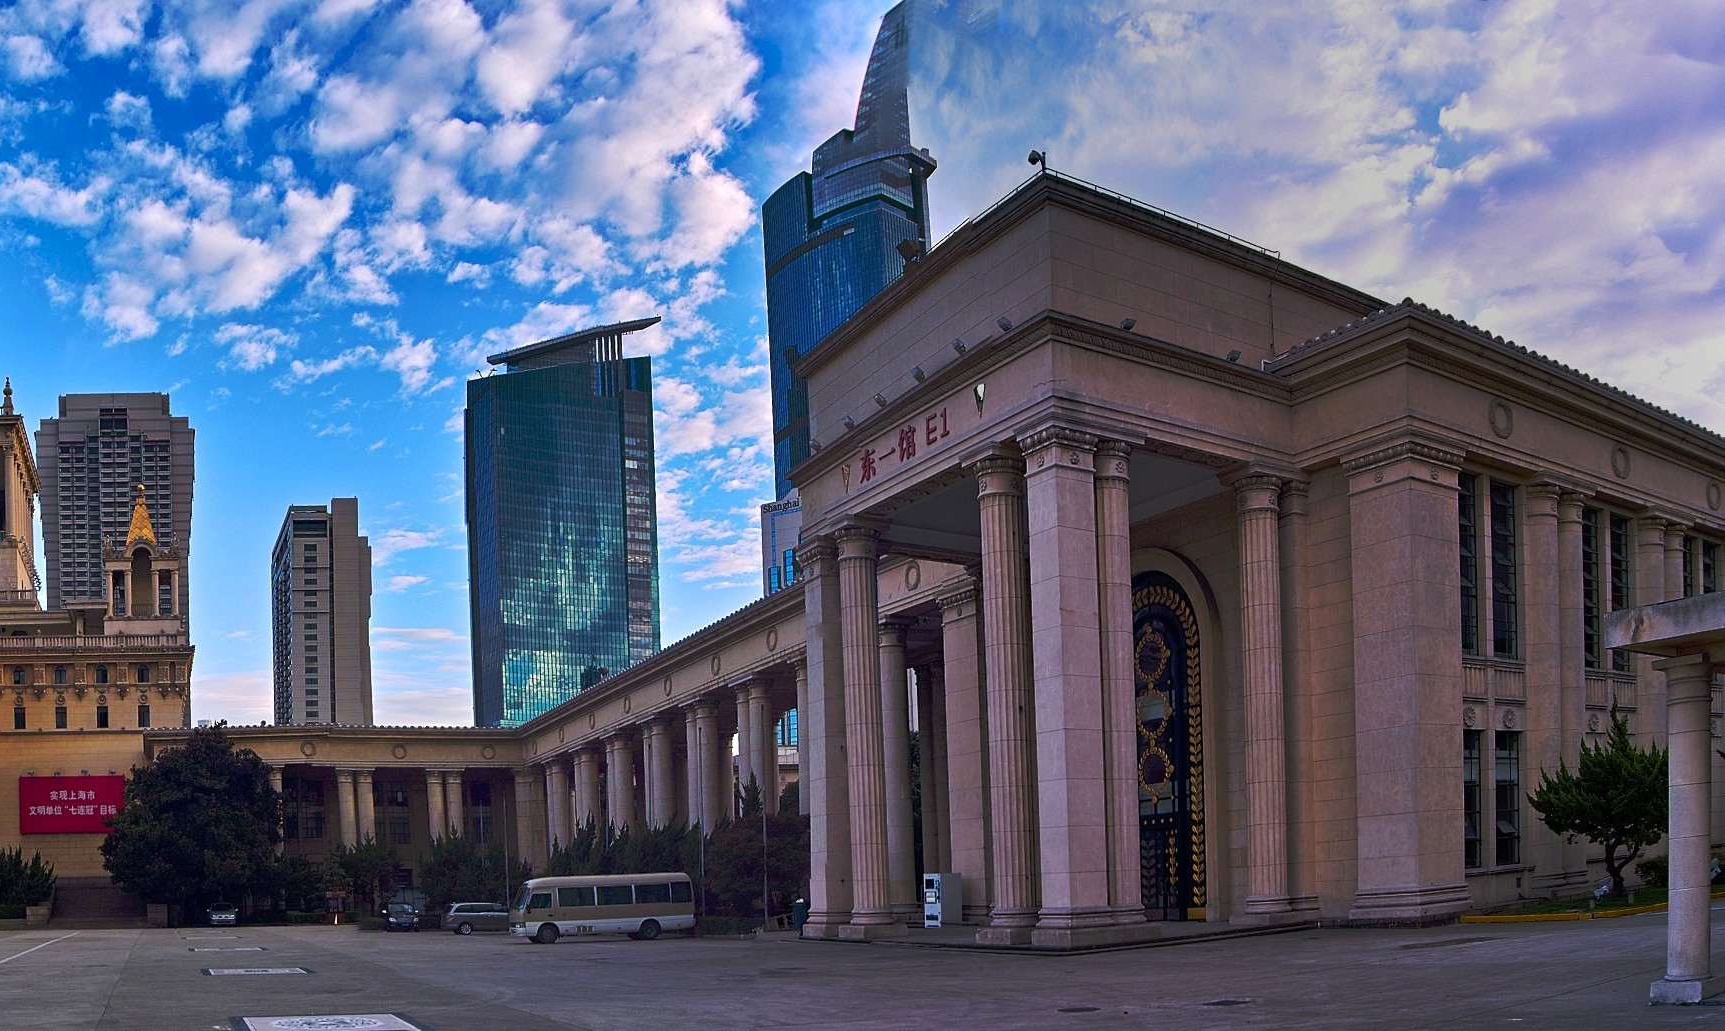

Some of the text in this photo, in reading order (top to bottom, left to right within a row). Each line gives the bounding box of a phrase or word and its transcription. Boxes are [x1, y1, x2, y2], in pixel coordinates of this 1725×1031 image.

[860, 407, 950, 484] 东一馆 E1
[762, 497, 800, 514] Shanghai
[50, 790, 95, 801] 实现上海市
